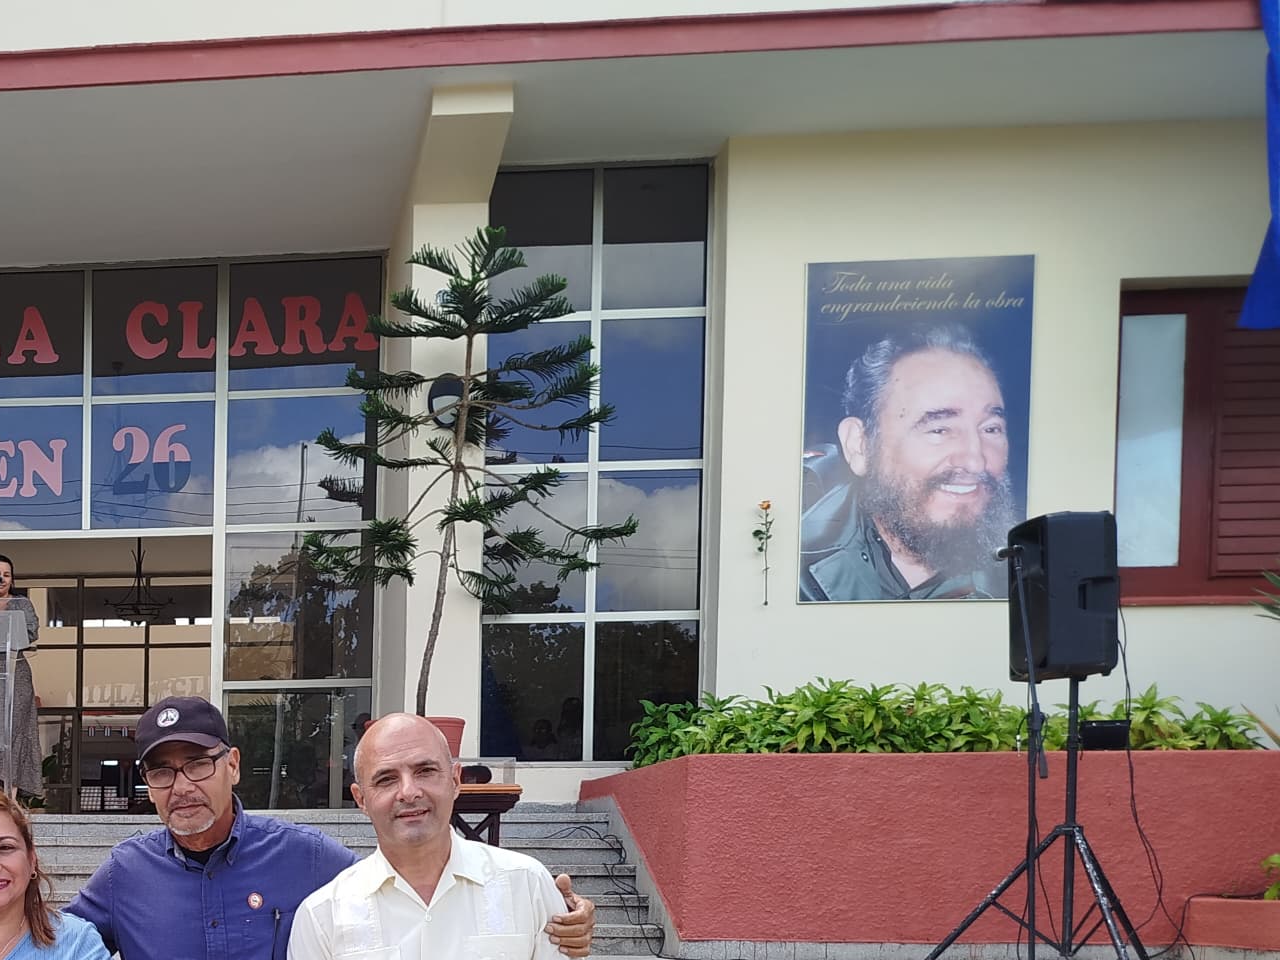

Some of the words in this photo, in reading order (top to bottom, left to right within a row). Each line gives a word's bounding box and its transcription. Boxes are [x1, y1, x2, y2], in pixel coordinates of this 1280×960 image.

[820, 294, 959, 322] engrandeciendo
[962, 292, 980, 309] la
[985, 290, 1025, 309] obra
[822, 271, 872, 293] Toda
[876, 279, 911, 291] una
[915, 272, 955, 291] vida
[125, 292, 379, 359] CLARA
[112, 424, 192, 496] 26
